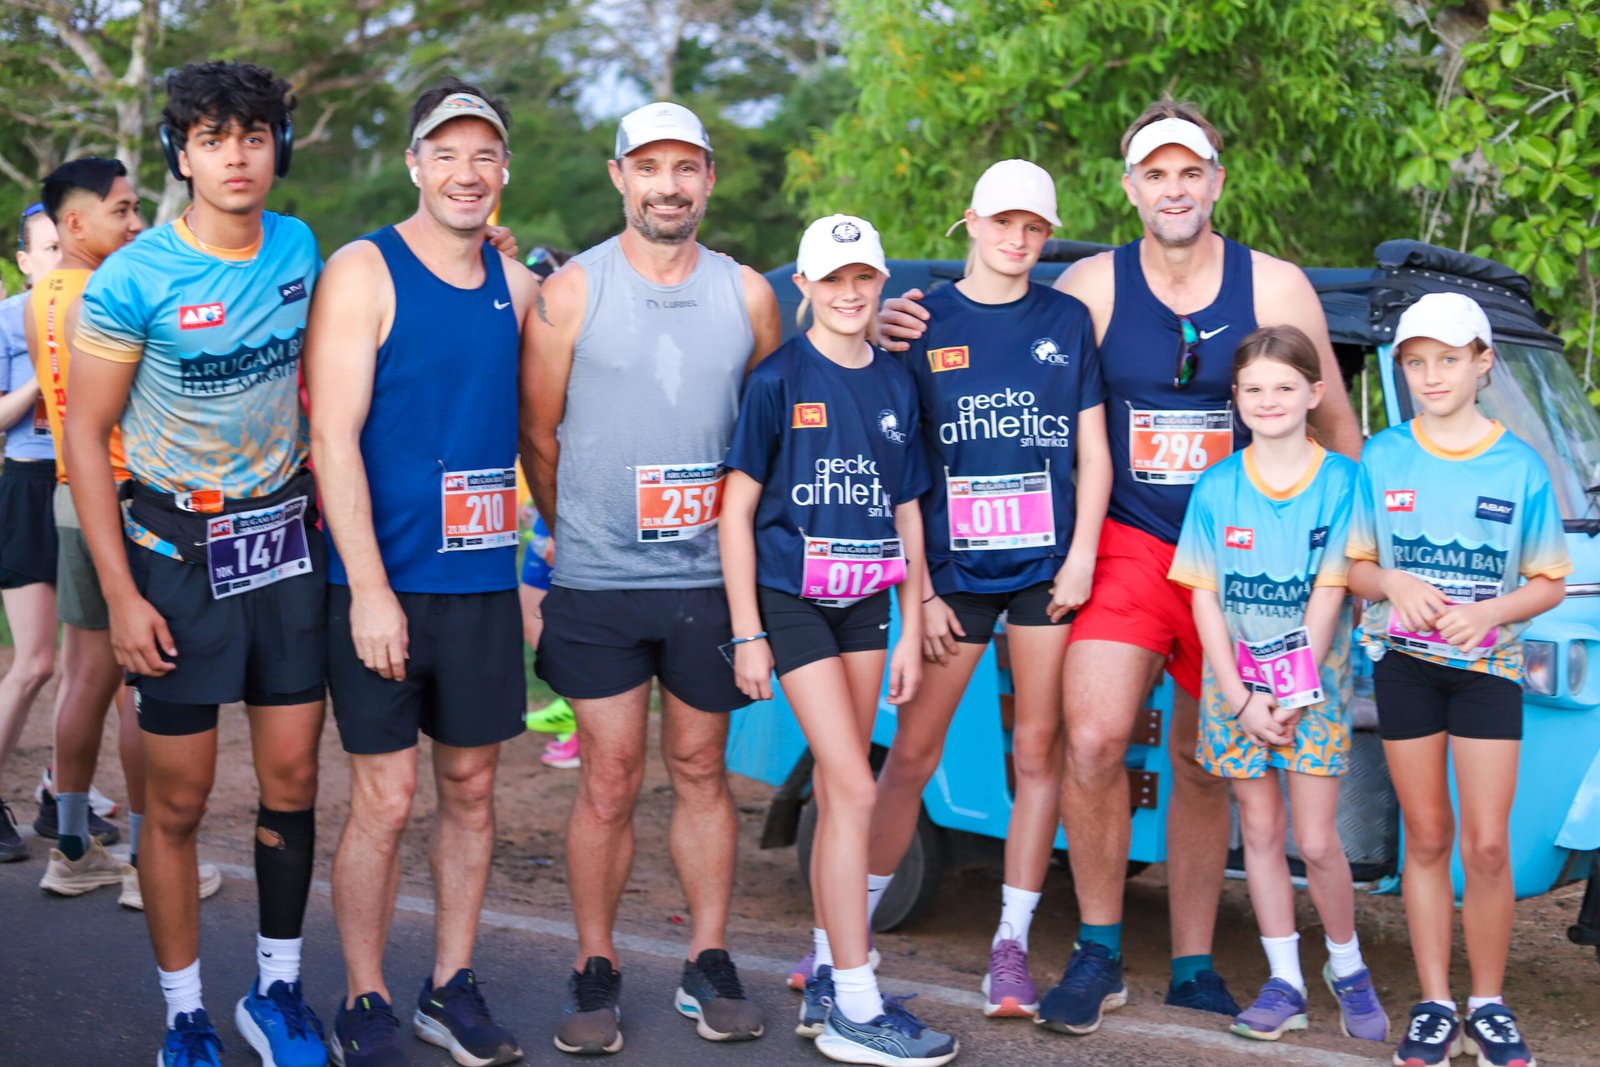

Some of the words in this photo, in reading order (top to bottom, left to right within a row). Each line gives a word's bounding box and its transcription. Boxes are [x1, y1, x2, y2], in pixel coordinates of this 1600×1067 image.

[185, 346, 284, 378] ARUGAM
[957, 387, 1036, 415] gecko
[939, 407, 1070, 445] athletics
[1019, 435, 1034, 447] sri
[1035, 435, 1069, 447] lanka
[1151, 433, 1208, 470] 296
[661, 485, 717, 526] 259
[791, 473, 891, 506] athlet
[465, 493, 504, 532] 210
[868, 505, 883, 517] sri
[972, 498, 1022, 534] 011
[1478, 502, 1513, 514] ABAY
[233, 526, 287, 574] 147
[1393, 545, 1466, 568] RUGAM
[1470, 552, 1506, 574] BAY
[215, 565, 235, 579] 10K
[827, 562, 884, 596] 012
[809, 585, 824, 595] 5K
[1226, 580, 1303, 602] RUGAM
[1242, 666, 1257, 678] 5K
[1259, 657, 1296, 694] 13
